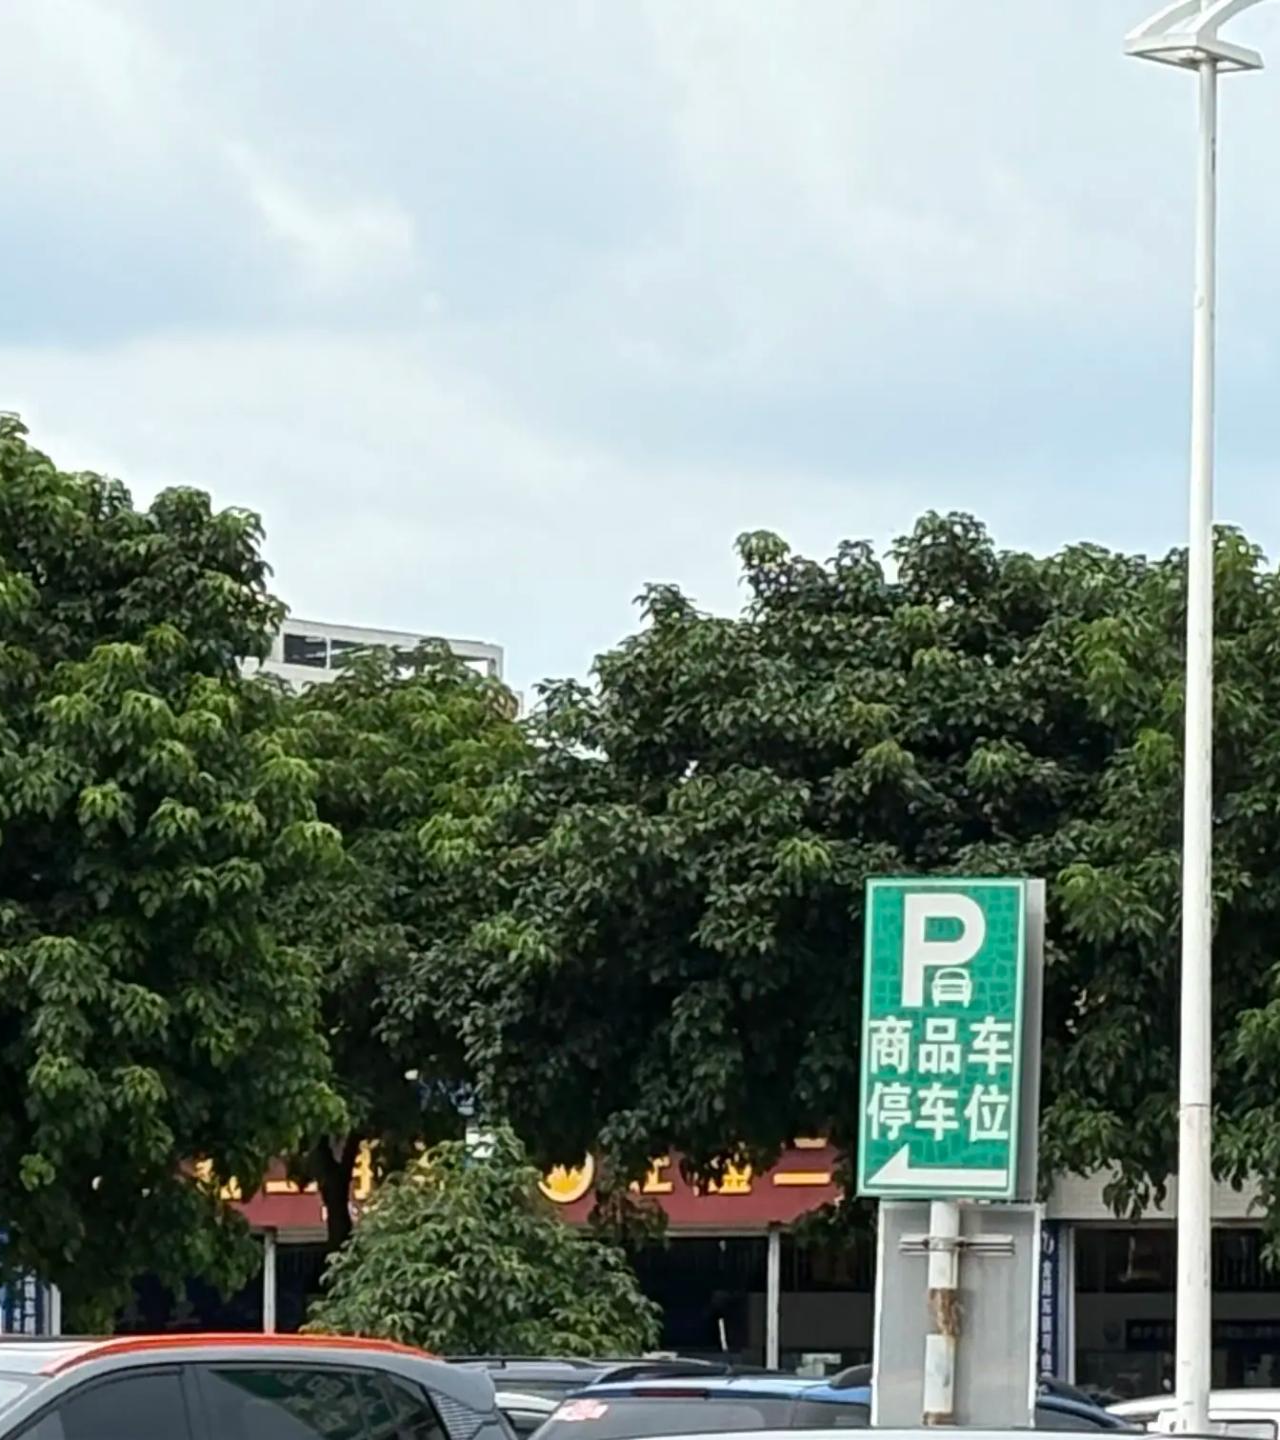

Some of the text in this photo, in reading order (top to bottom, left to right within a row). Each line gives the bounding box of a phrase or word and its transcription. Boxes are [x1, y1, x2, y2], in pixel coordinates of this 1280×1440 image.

[902, 893, 985, 1007] P
[869, 1016, 1013, 1075] 商品车
[867, 1083, 1009, 1141] 停车位
